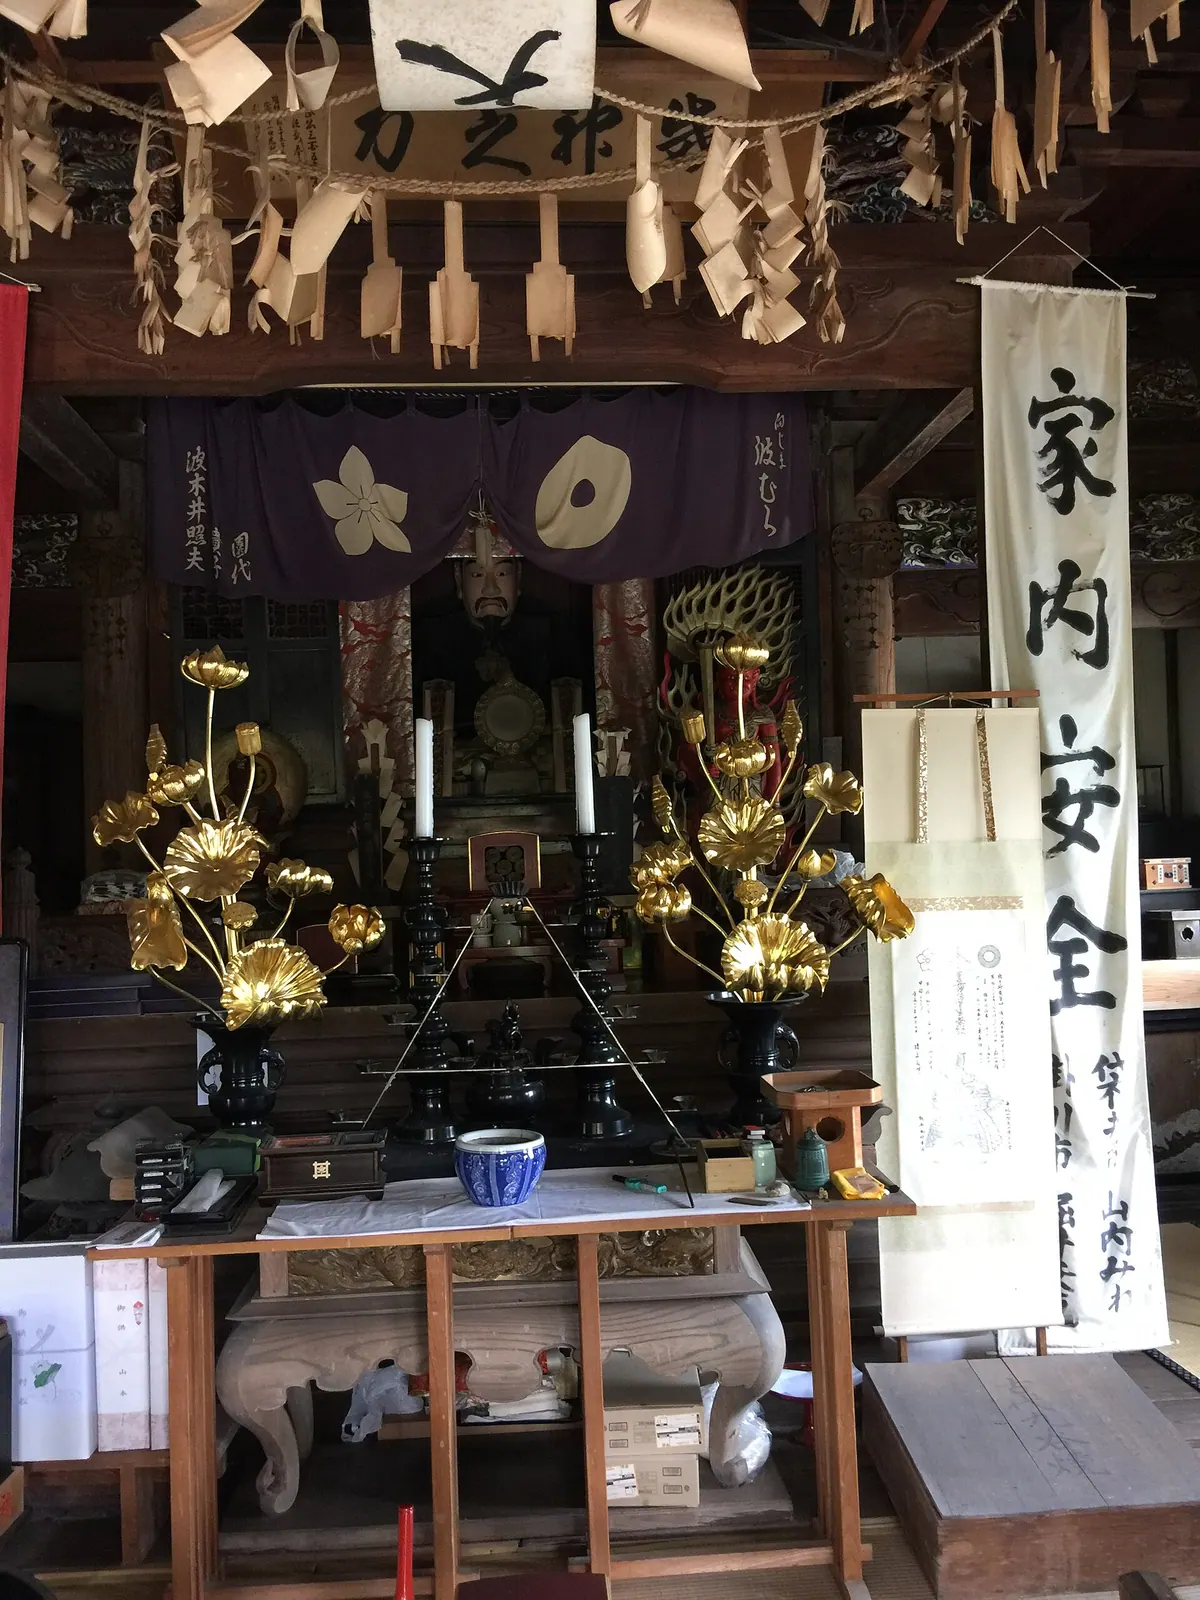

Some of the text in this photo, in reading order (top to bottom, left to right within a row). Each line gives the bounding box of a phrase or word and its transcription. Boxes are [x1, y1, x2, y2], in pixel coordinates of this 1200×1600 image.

[184, 445, 207, 572] 波木井照夫
[1026, 367, 1128, 1017] 家内安全
